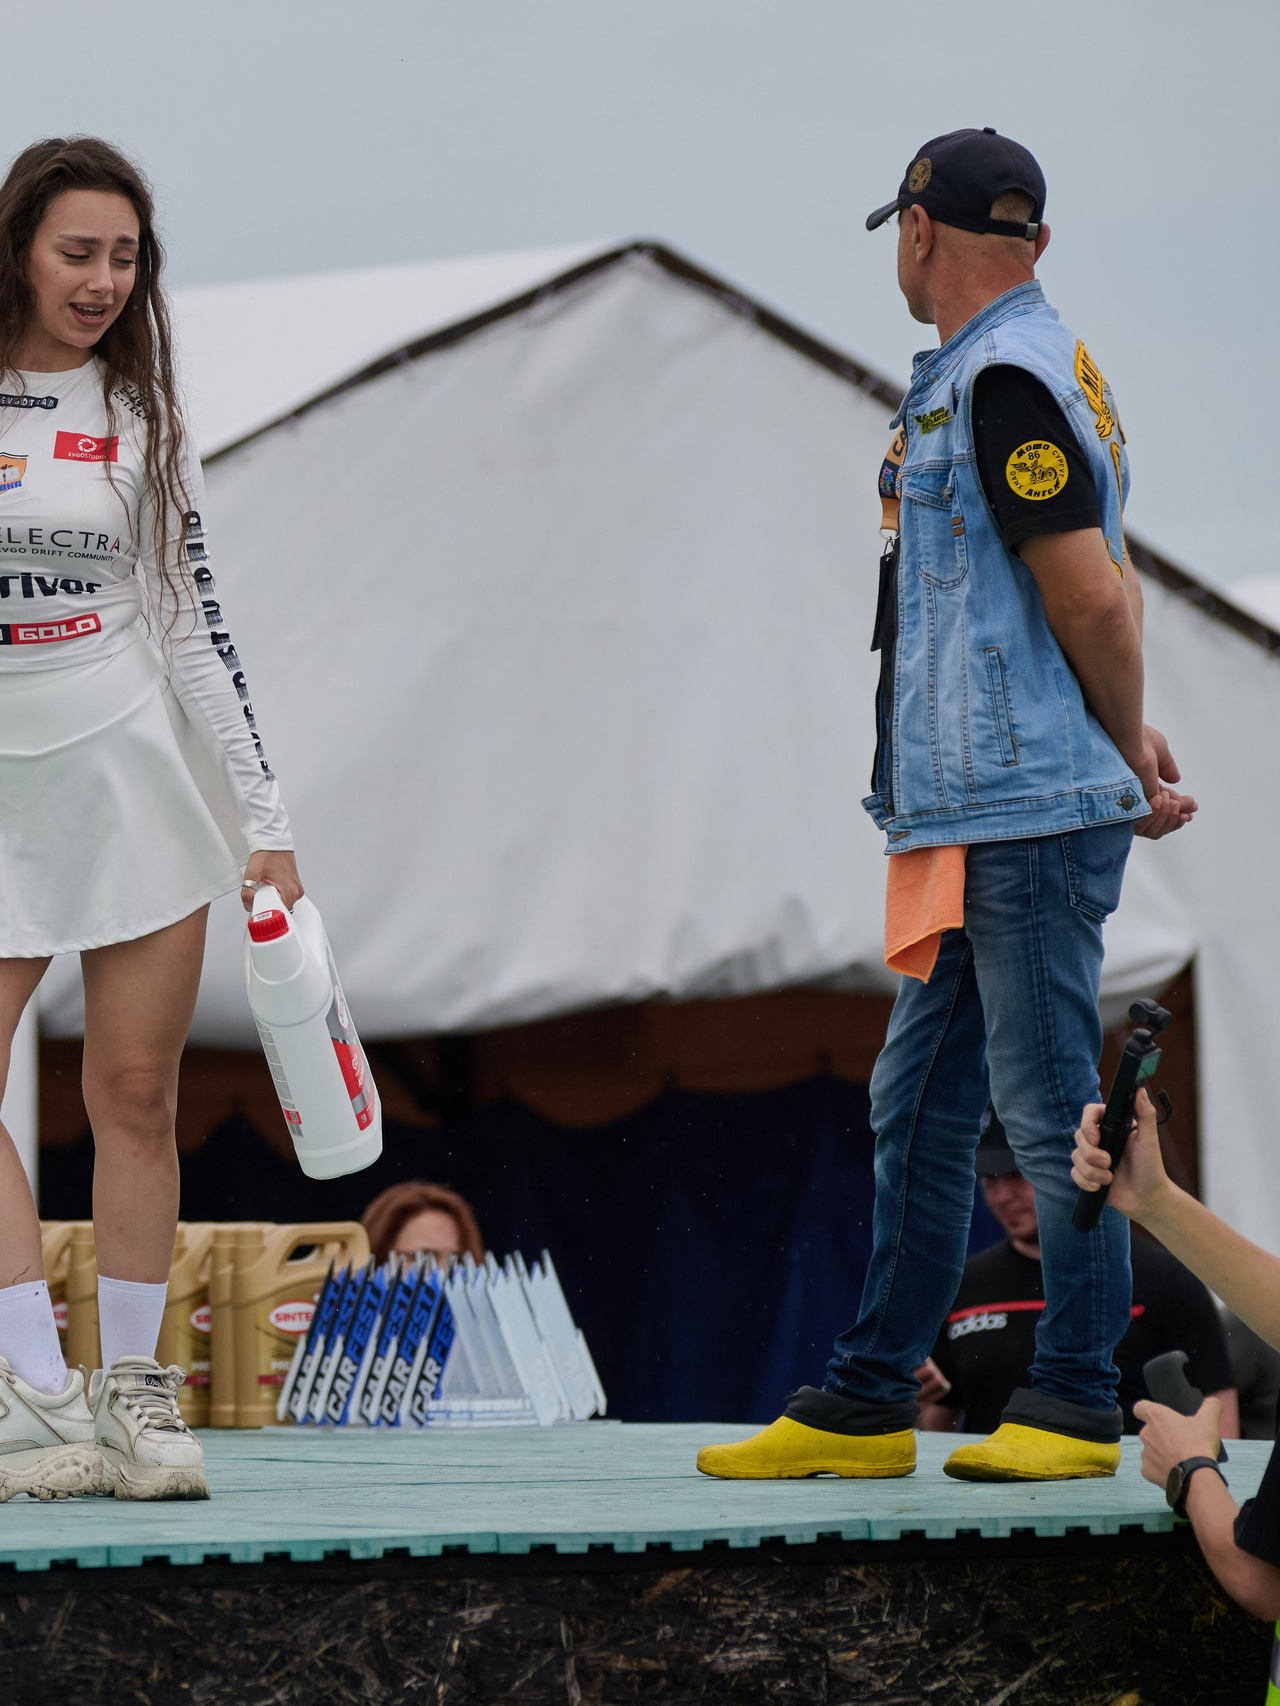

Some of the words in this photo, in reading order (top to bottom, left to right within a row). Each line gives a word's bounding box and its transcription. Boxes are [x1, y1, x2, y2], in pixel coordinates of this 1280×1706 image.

[1028, 450, 1041, 461] 86
[1052, 449, 1065, 478] СУРГУТ
[1010, 470, 1024, 491] ХМАО
[32, 548, 64, 557] DRIFT
[67, 551, 116, 562] COMMUNITY
[274, 1311, 313, 1322] SINTE
[948, 1312, 1009, 1340] adidas
